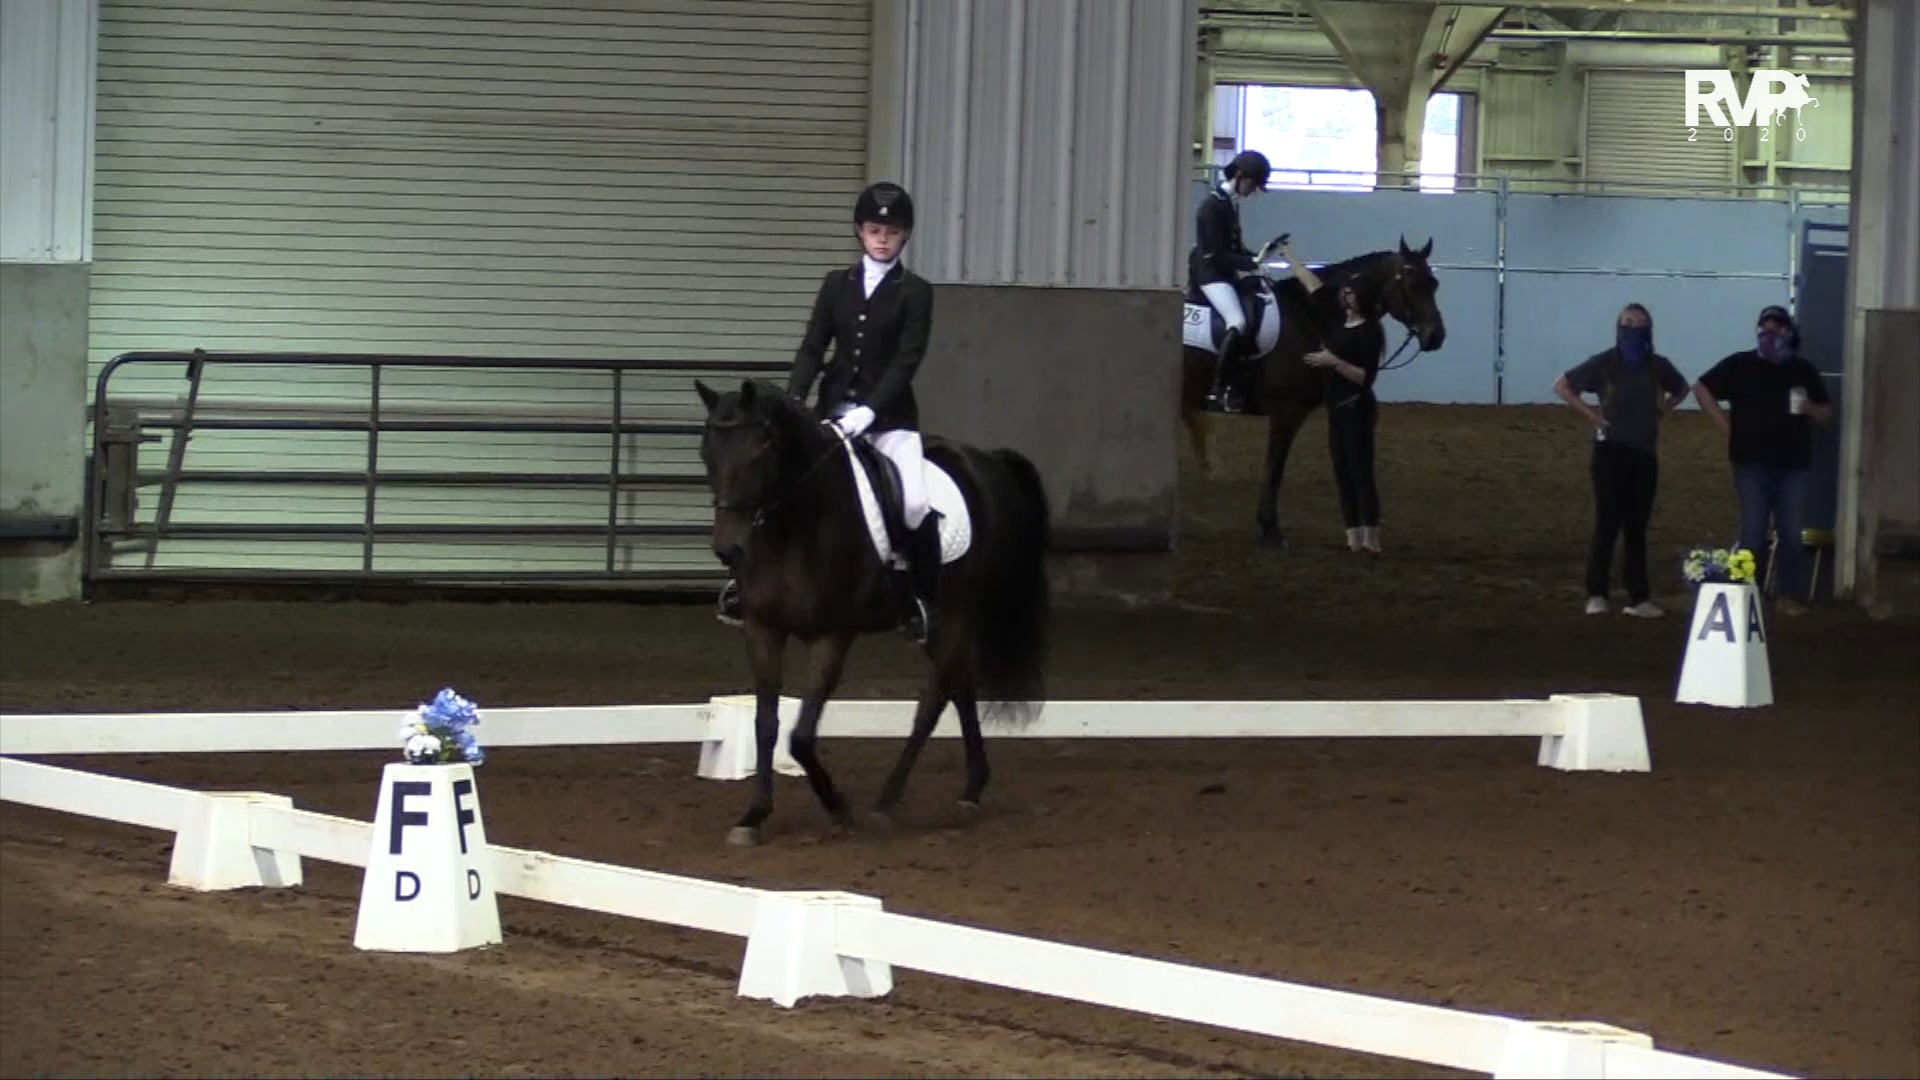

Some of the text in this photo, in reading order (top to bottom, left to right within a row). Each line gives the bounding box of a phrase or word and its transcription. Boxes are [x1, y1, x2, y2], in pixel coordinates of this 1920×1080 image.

[1698, 592, 1736, 642] A
[1747, 593, 1765, 643] A
[389, 781, 432, 855] F
[453, 779, 475, 855] F
[395, 871, 421, 902] D
[467, 869, 481, 900] D
